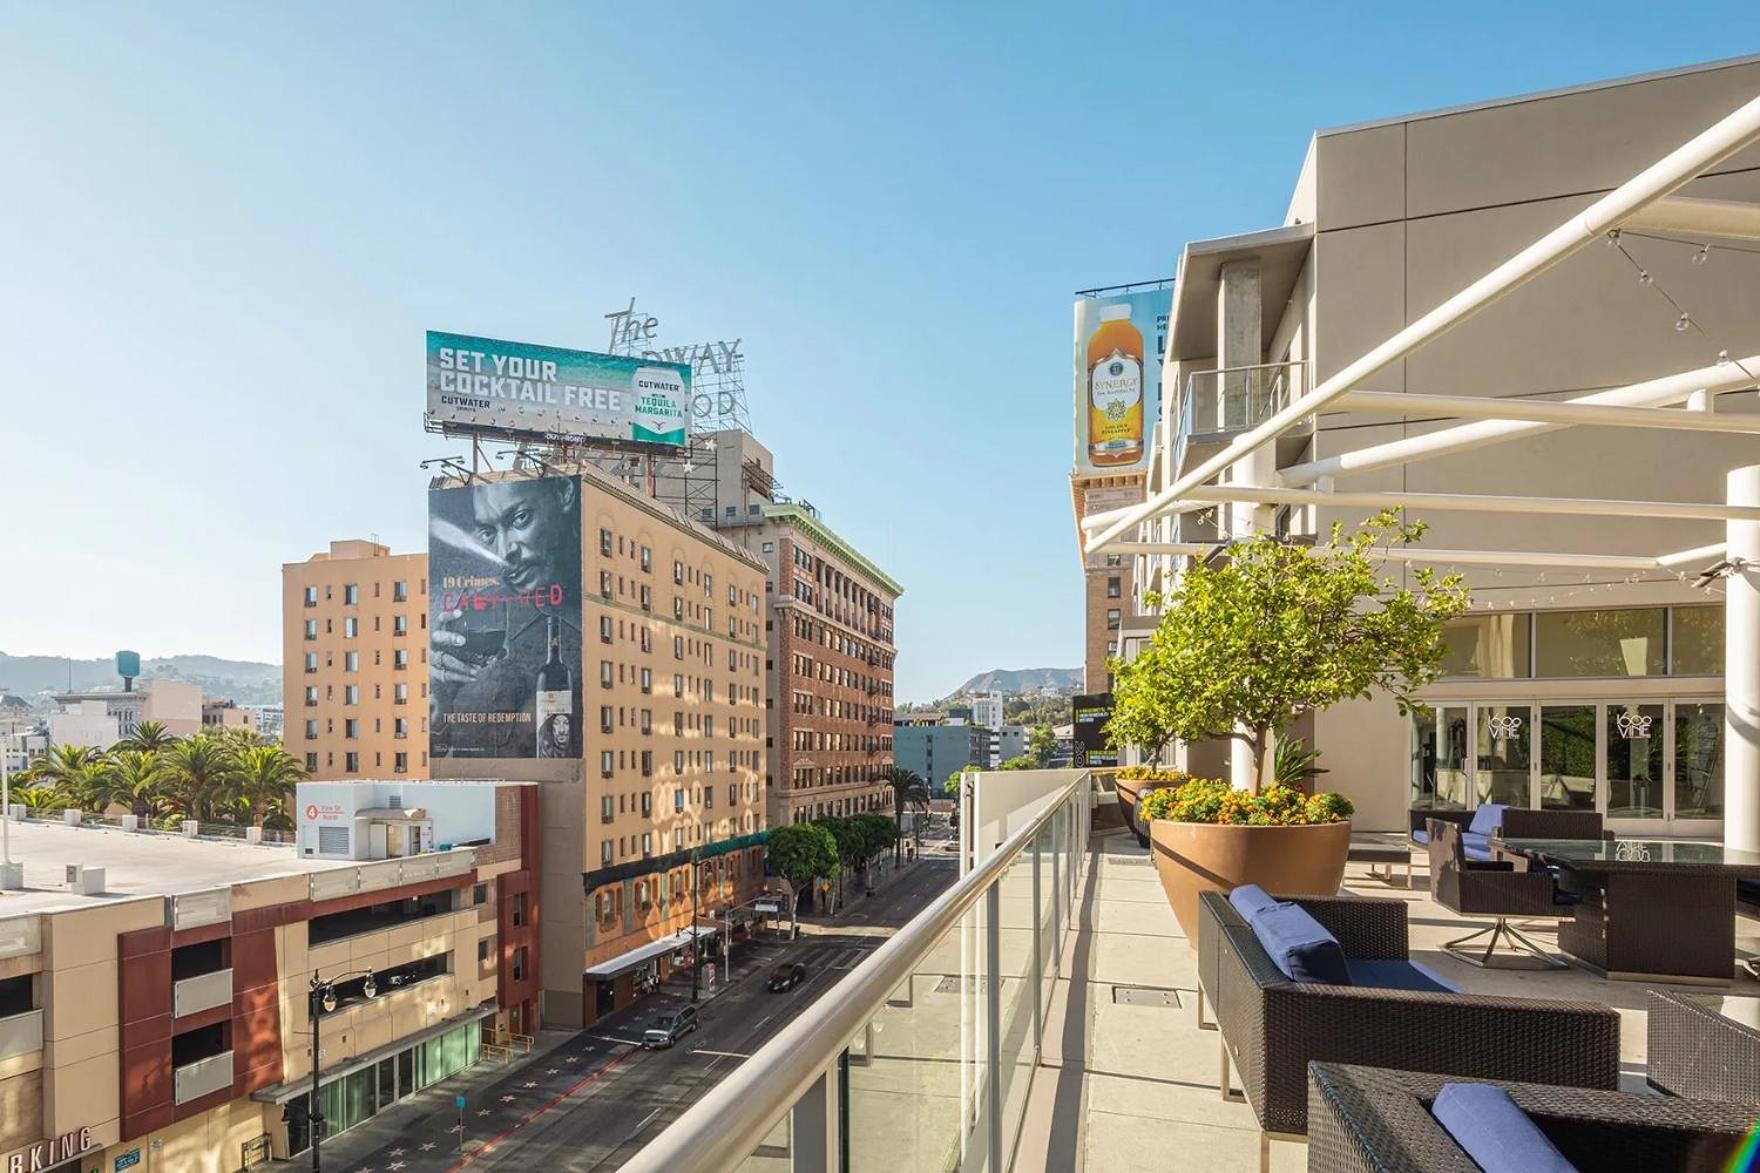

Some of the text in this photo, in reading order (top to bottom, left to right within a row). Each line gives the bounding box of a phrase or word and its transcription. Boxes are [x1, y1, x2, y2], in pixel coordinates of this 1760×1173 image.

[604, 297, 659, 354] The
[440, 348, 557, 382] SET YOUR
[440, 370, 621, 411] COCKTAIL FREE
[638, 380, 680, 392] CUTWATER
[441, 396, 490, 408] CUTWATER
[641, 396, 676, 408] TEQUILA
[635, 405, 682, 418] MARGARITA
[443, 712, 531, 724] THE TASTE OF REDEMPTION
[1489, 725, 1520, 739] VINE
[1617, 725, 1651, 739] VINE
[10, 1126, 91, 1173] RKING
